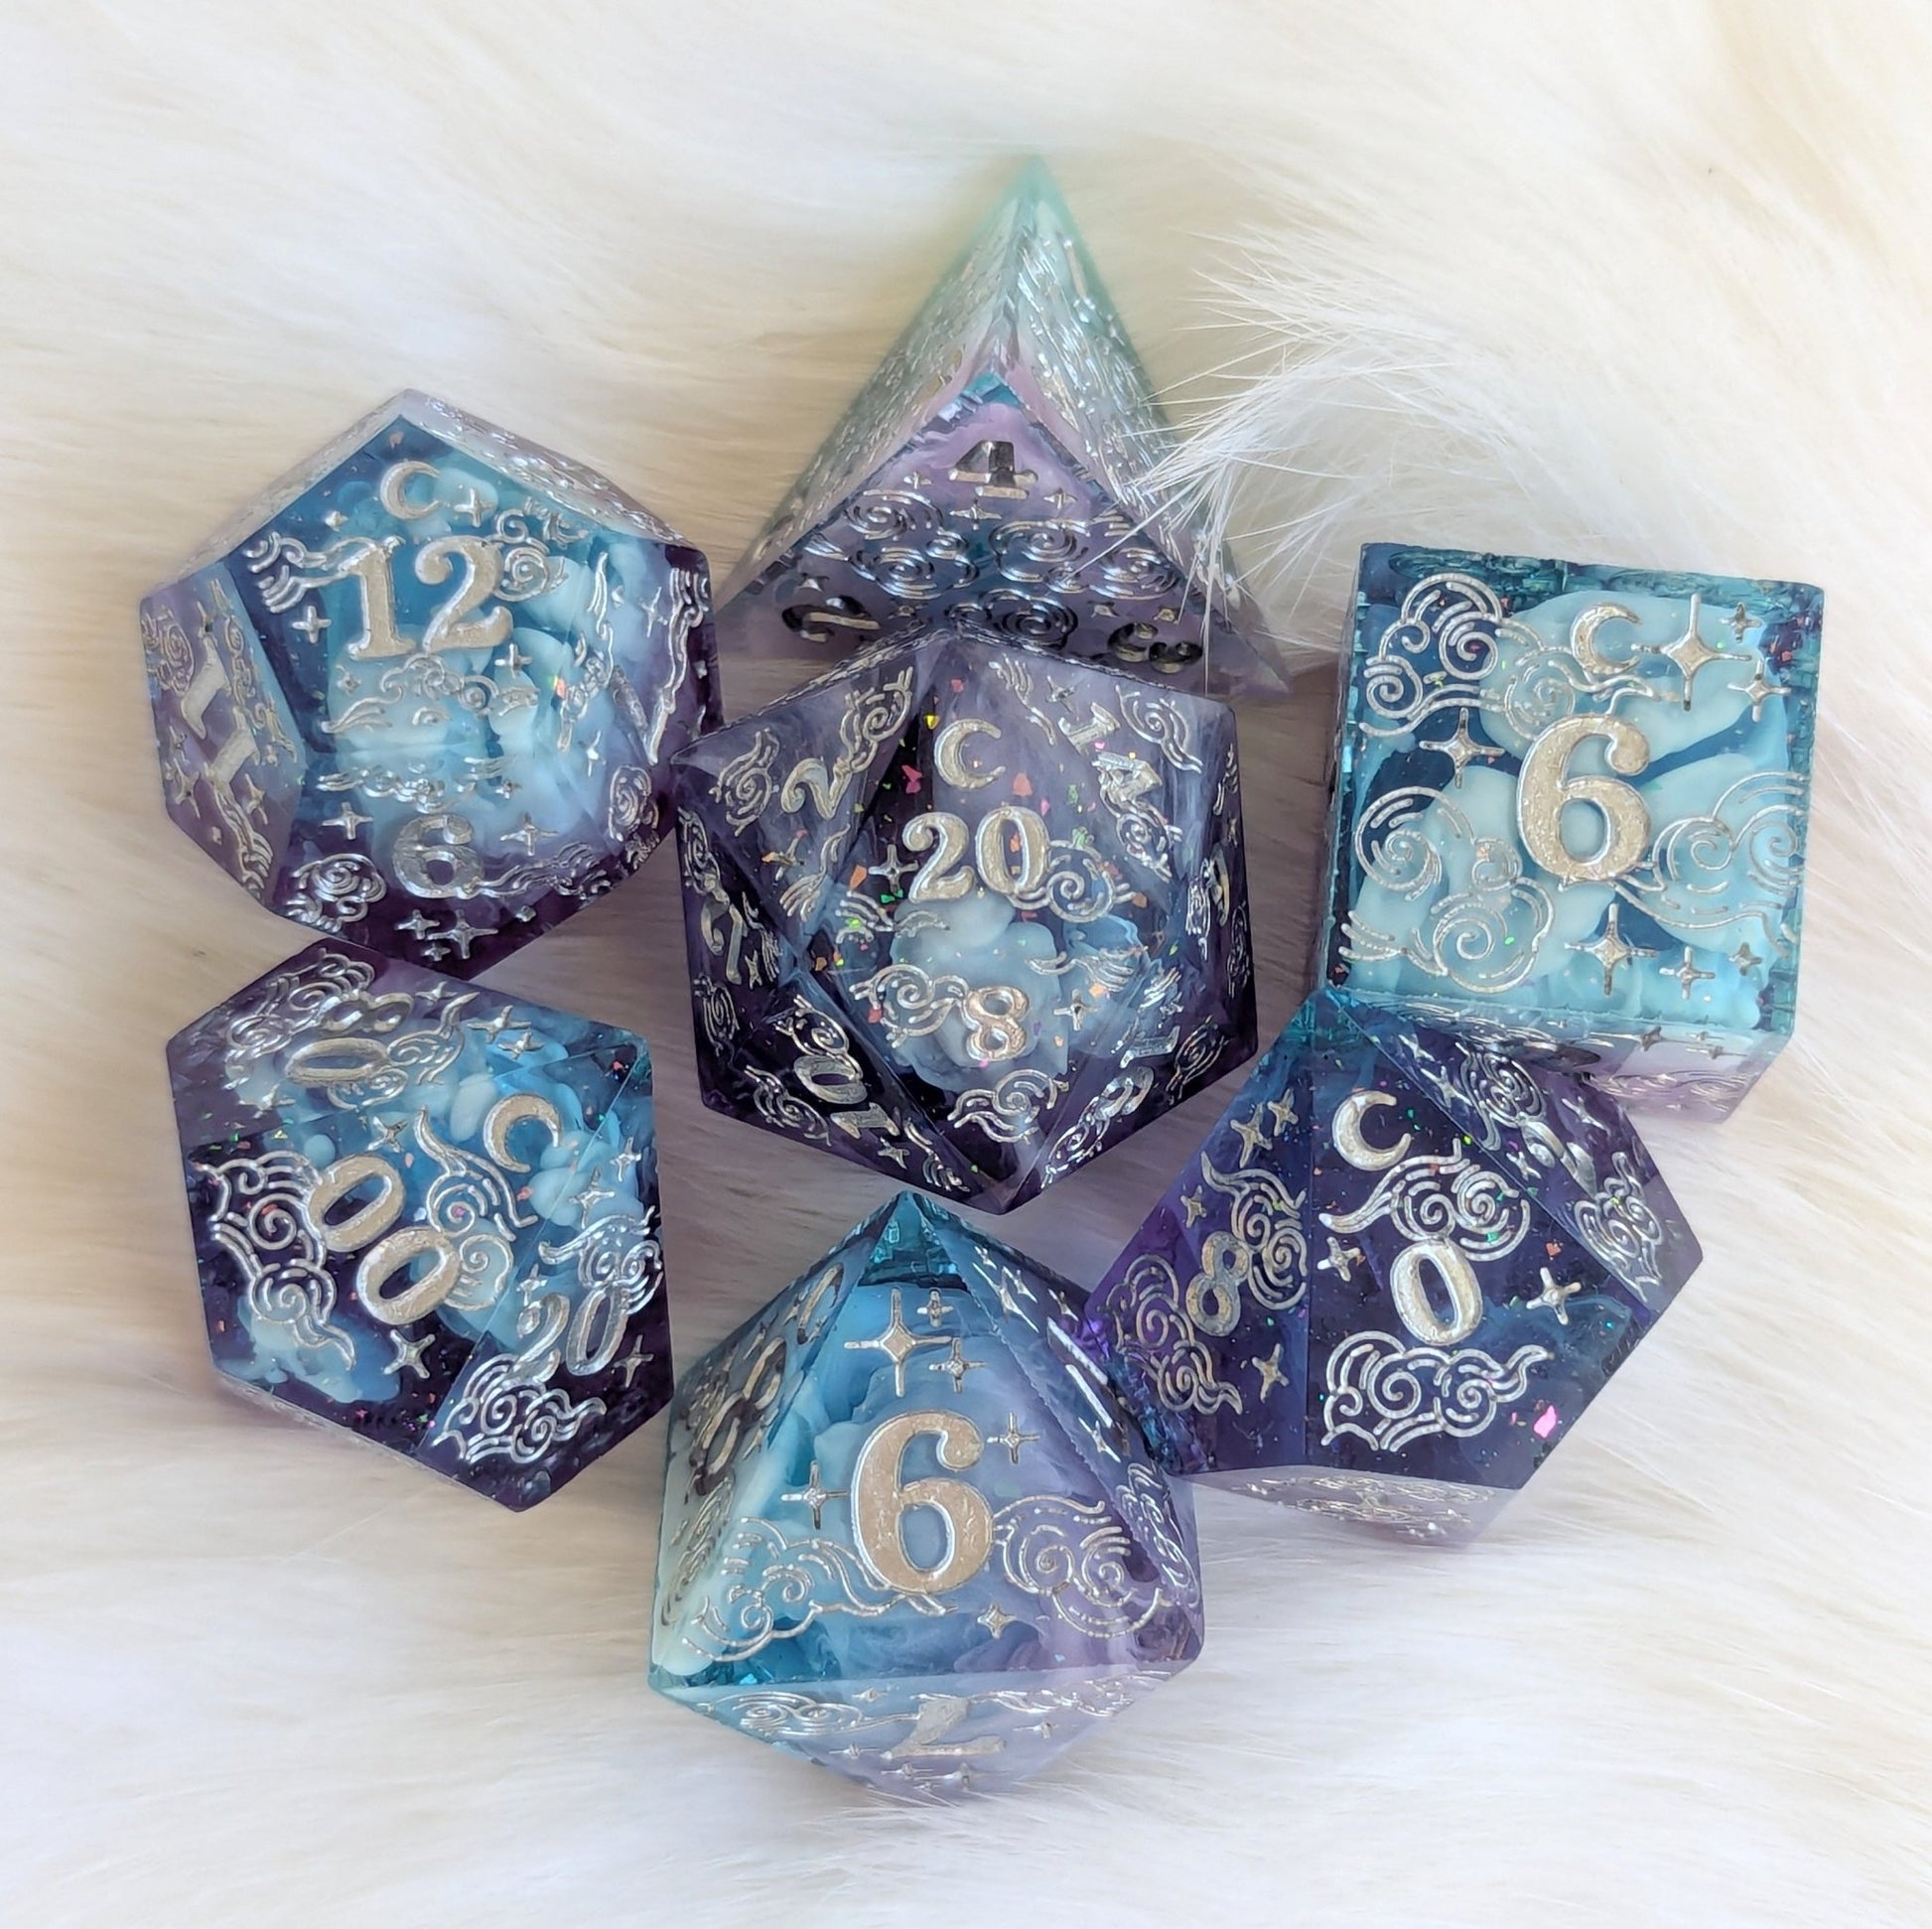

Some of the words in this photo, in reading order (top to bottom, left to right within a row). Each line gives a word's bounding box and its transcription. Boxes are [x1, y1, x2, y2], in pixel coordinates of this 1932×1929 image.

[343, 535, 514, 659] 12
[780, 757, 856, 821] 2
[1517, 713, 1651, 884] 6
[392, 813, 483, 898] 6
[902, 805, 1049, 903] 20
[963, 985, 1031, 1062] 8
[306, 1153, 463, 1327] 00
[1187, 1231, 1251, 1338] 8
[1390, 1238, 1483, 1346] 0
[513, 1290, 626, 1381] 20
[850, 1409, 995, 1594] 6
